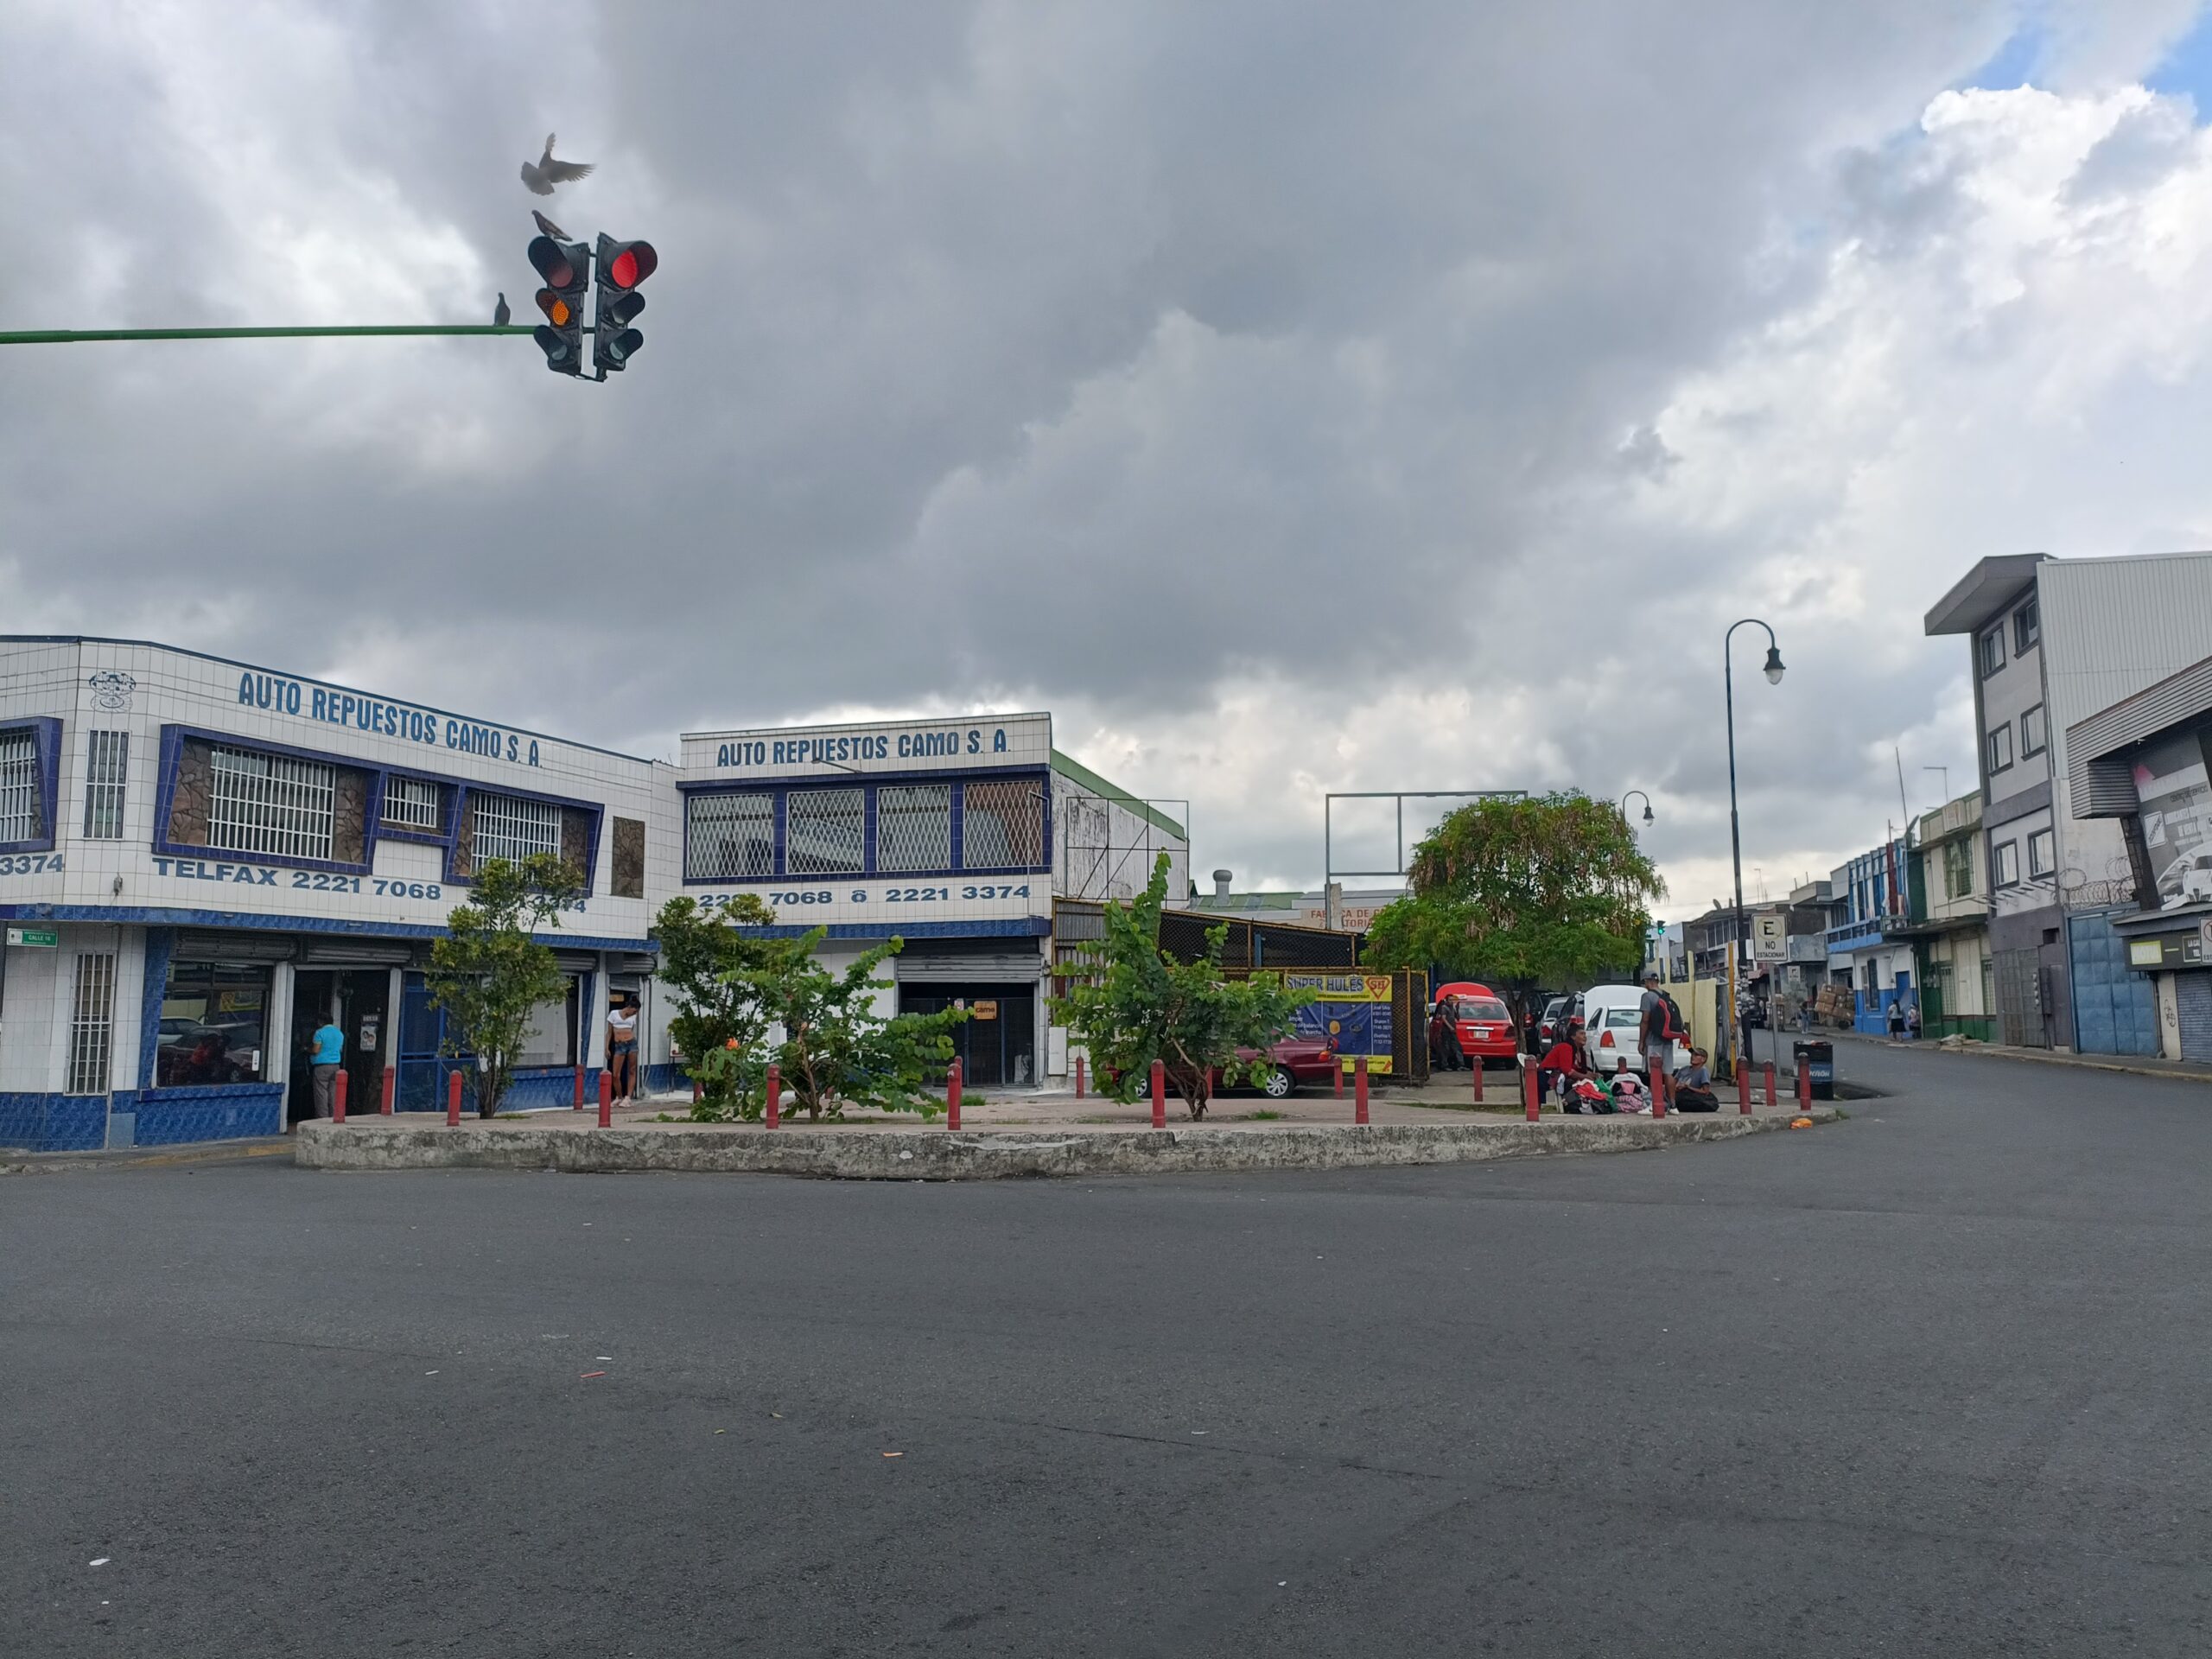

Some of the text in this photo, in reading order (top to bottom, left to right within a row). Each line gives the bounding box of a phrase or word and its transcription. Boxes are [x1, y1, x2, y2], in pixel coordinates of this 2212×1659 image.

[238, 672, 301, 715] AUTO
[312, 688, 436, 745] REPUESTOS
[446, 720, 501, 760] CAMO
[717, 741, 766, 767] AUTO
[773, 735, 888, 765] REPUESTOS
[898, 732, 959, 758] CAMO
[0, 854, 64, 876] 3374
[152, 857, 442, 901] TELFAX 2221 7068
[769, 891, 833, 906] 7068
[886, 888, 950, 903] 2221
[962, 885, 1030, 899] 3374
[1357, 909, 1370, 918] DE
[1765, 940, 1777, 950] NO
[1287, 976, 1364, 992] SUPER HULES
